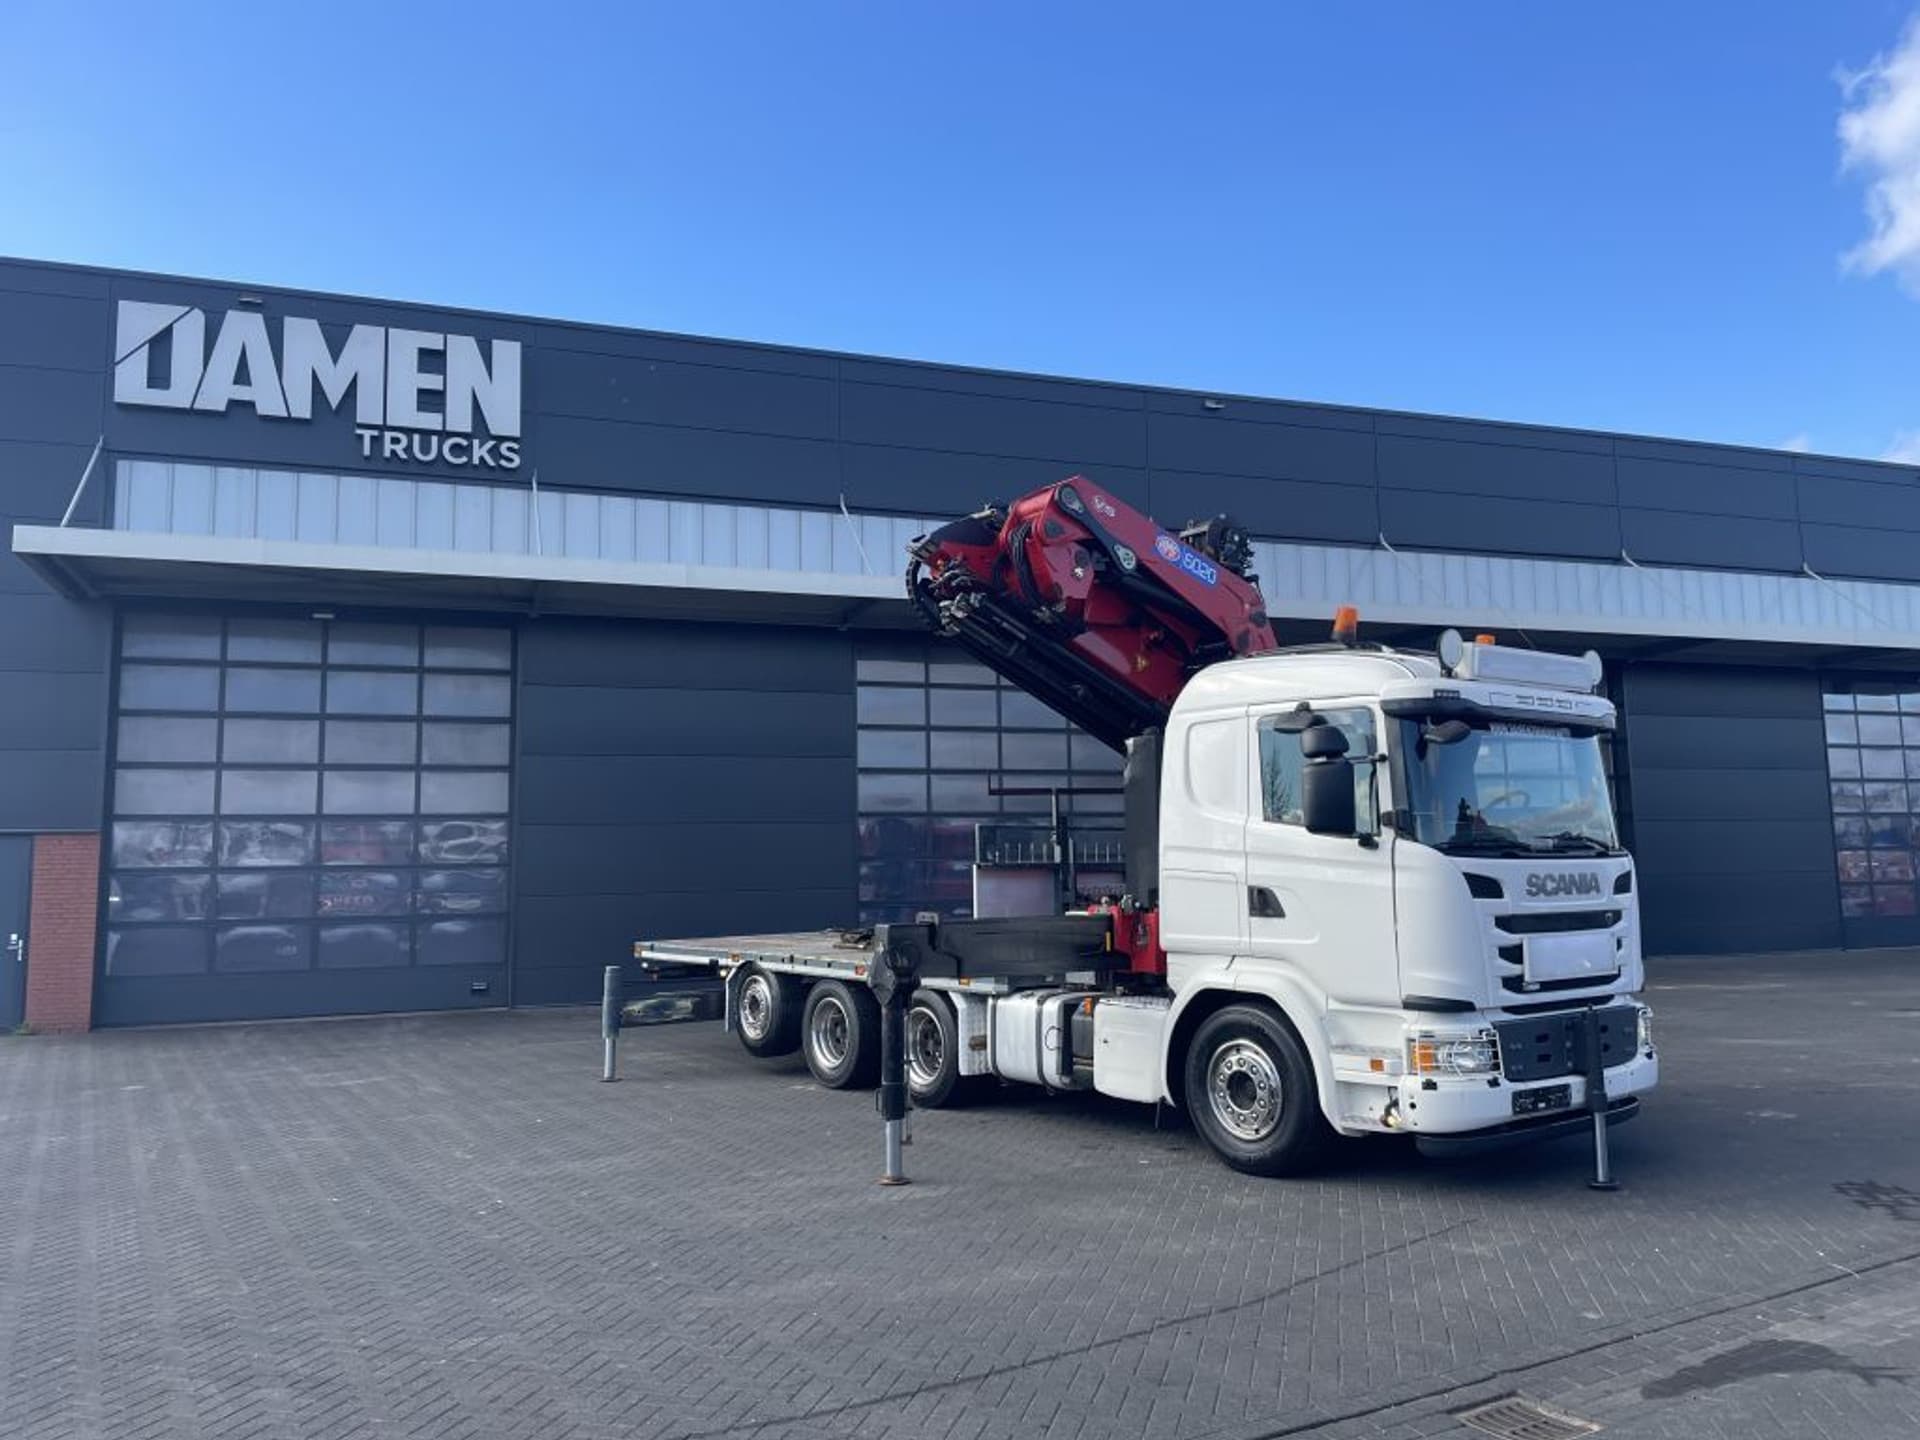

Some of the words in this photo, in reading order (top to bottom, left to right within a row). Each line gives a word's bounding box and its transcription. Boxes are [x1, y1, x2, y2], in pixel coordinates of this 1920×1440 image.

[114, 300, 521, 437] DAMEN
[355, 428, 521, 469] TRUCKS
[1525, 872, 1601, 897] SCANIA
